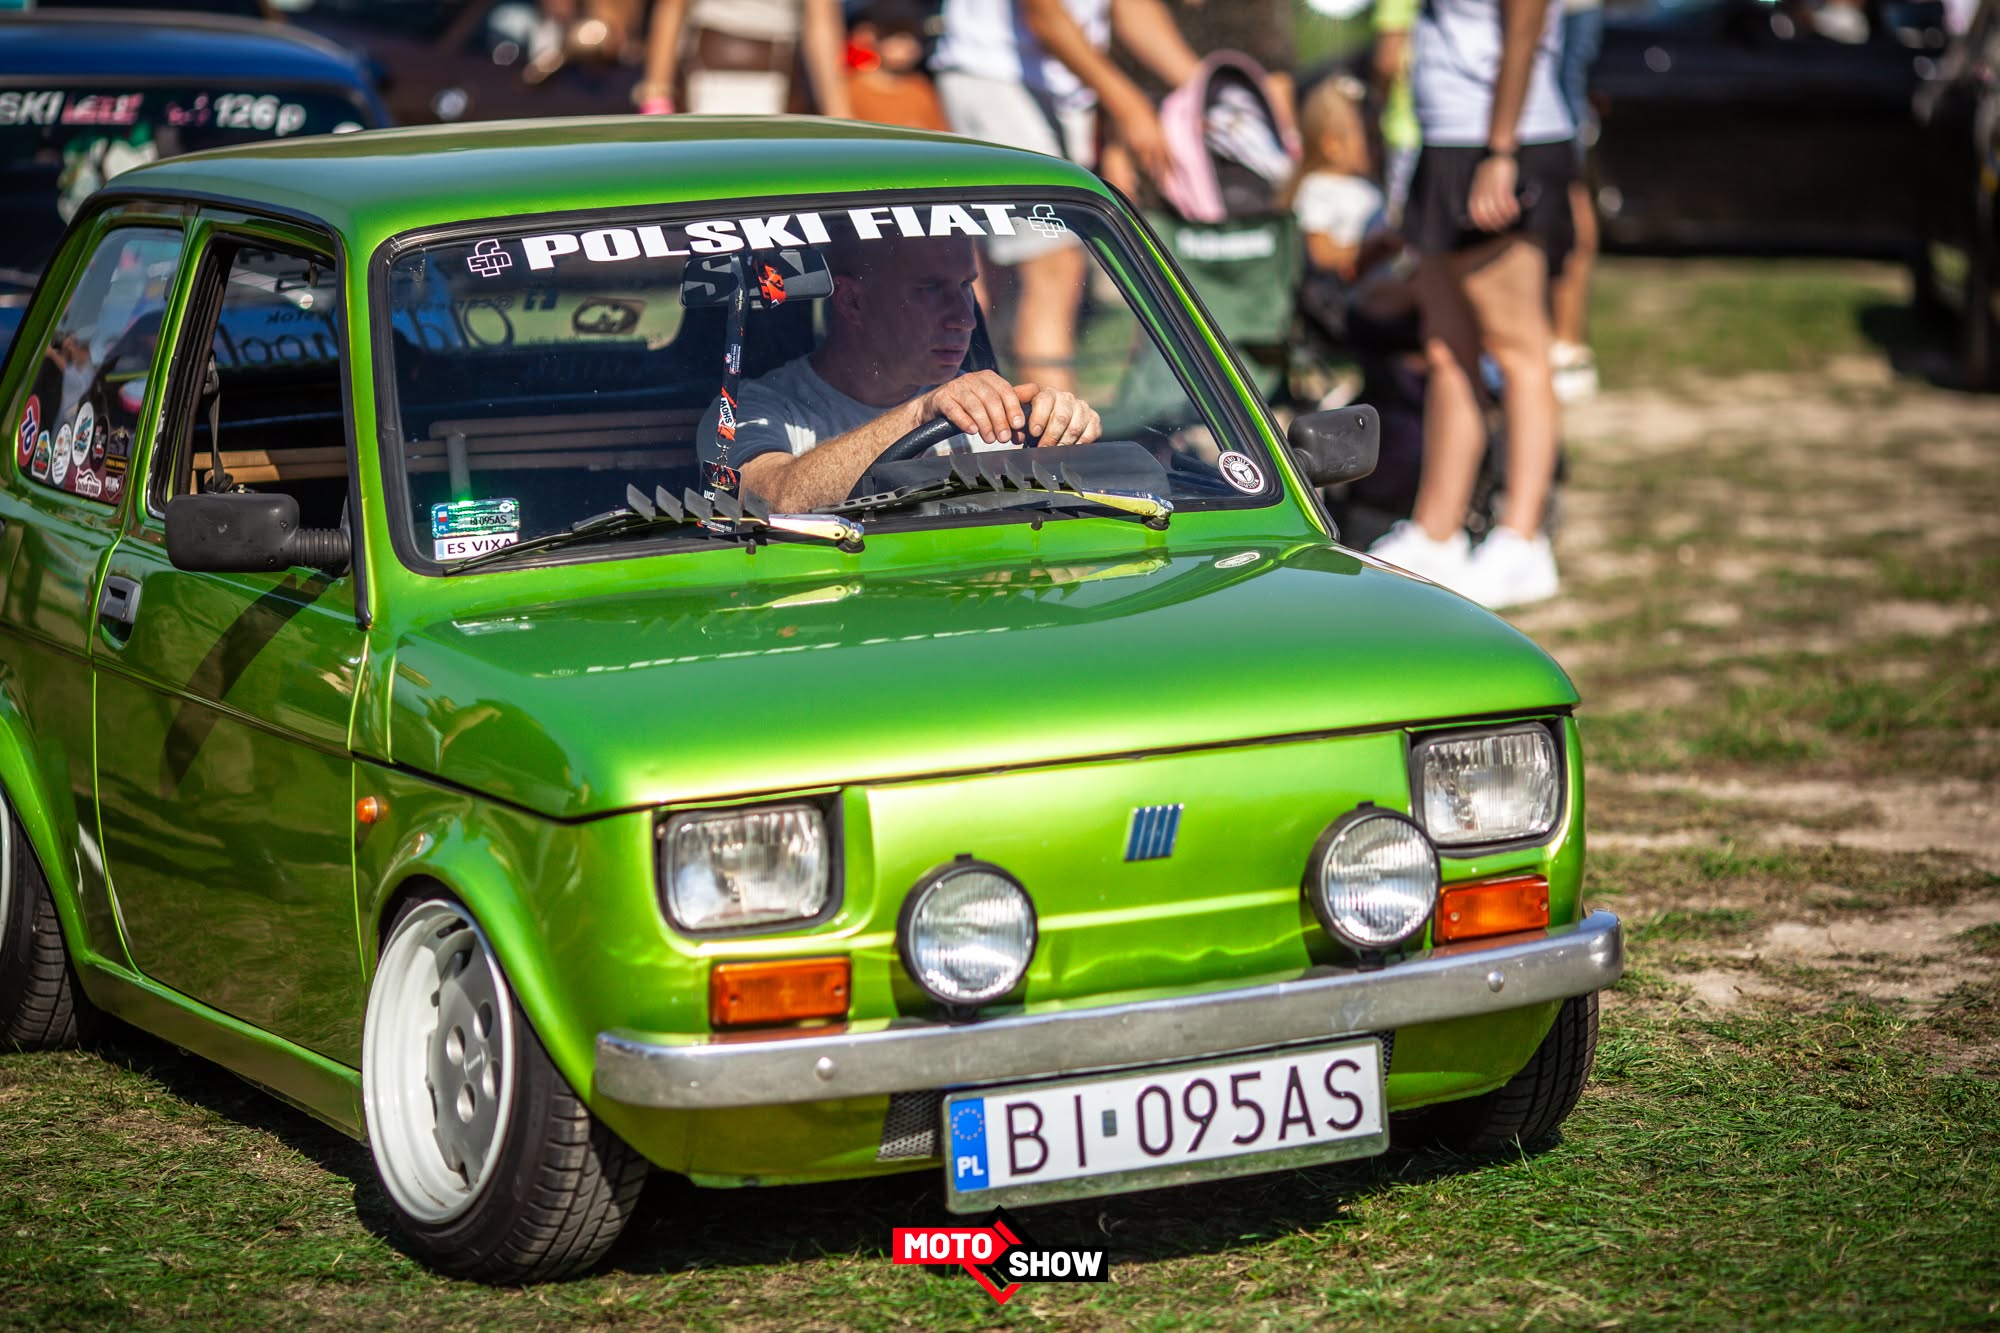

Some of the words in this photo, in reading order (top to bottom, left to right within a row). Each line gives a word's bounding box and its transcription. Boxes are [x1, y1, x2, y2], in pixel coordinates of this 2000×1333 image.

[213, 93, 307, 136] 126p
[520, 211, 833, 272] POLSKI
[847, 203, 1018, 241] FIAT
[447, 542, 466, 555] ES
[1005, 1094, 1087, 1176] BI
[1135, 1059, 1364, 1156] 095AS
[957, 1155, 985, 1179] PL
